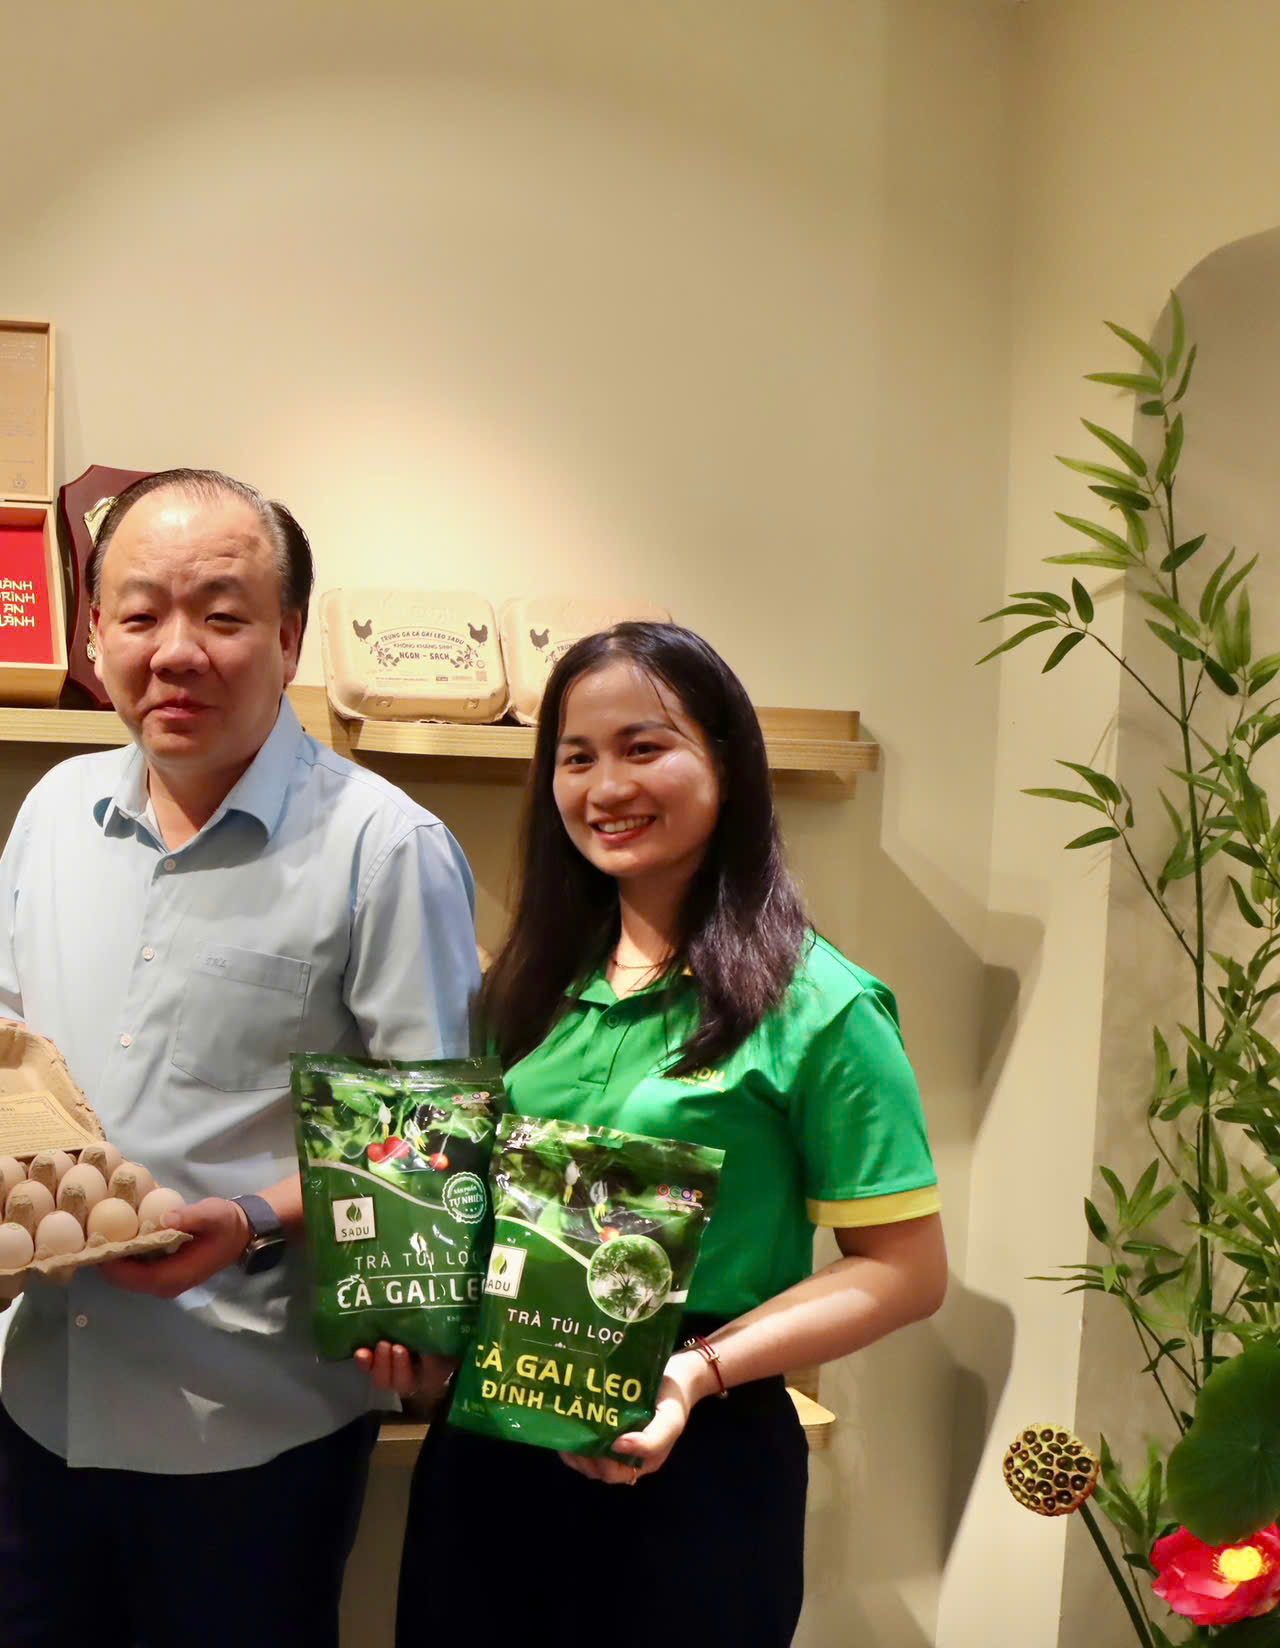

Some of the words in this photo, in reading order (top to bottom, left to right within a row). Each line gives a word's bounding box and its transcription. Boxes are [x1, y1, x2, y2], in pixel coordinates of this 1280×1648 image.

[656, 1184, 705, 1202] OCOP
[341, 1225, 370, 1238] SADU
[354, 1251, 391, 1270] TRÀ
[337, 1276, 373, 1309] CÀ
[385, 1279, 437, 1304] GAI
[449, 1278, 485, 1302] LE
[488, 1278, 511, 1292] ADU
[507, 1308, 542, 1328] TRÀ
[551, 1317, 580, 1335] TÚI
[587, 1325, 624, 1344] LỌC
[516, 1354, 574, 1387] GAI
[586, 1368, 642, 1402] LEO
[481, 1379, 544, 1410] ĐINH
[554, 1395, 619, 1428] LĂNG
